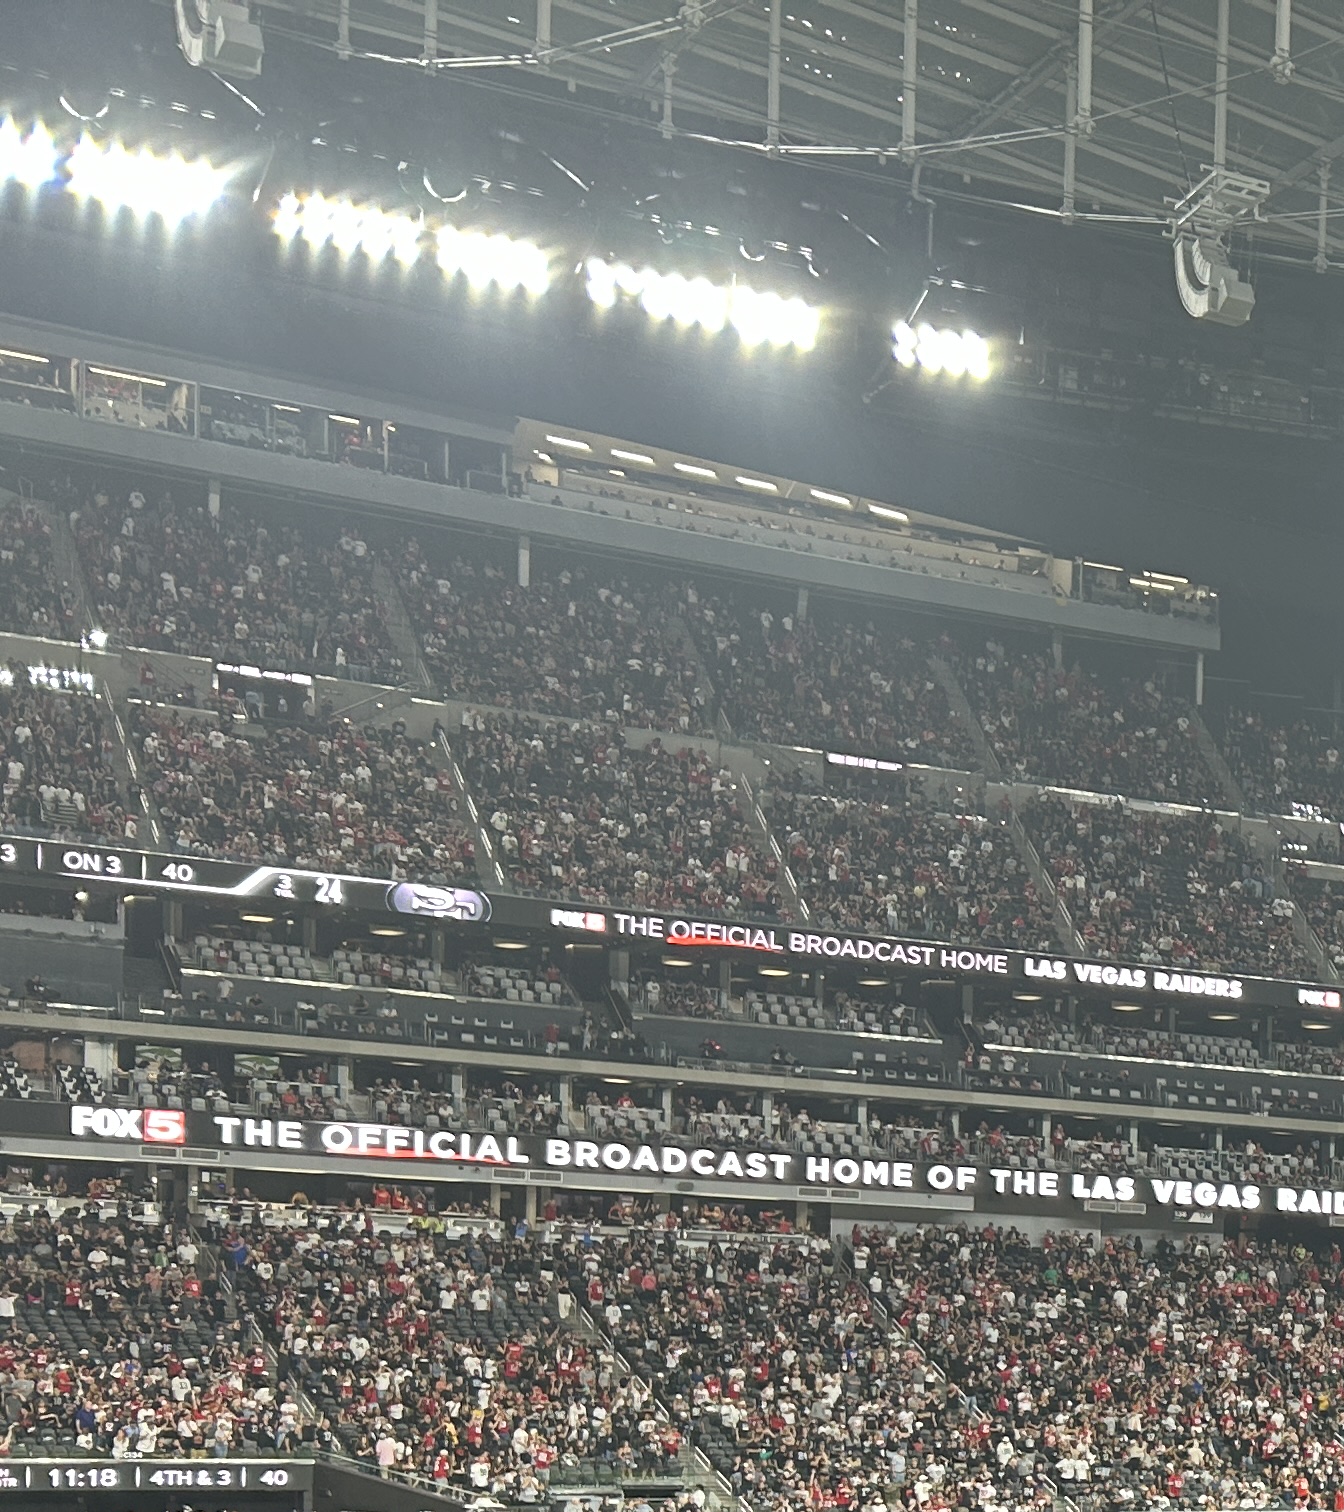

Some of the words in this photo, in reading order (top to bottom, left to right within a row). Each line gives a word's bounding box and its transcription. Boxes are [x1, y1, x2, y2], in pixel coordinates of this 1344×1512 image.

[62, 851, 100, 873] ON
[106, 855, 122, 875] 3
[162, 863, 193, 882] 40
[315, 877, 343, 903] 24
[614, 913, 664, 938] THE
[670, 920, 784, 952] OFFICIAL
[789, 932, 935, 966] BROADCAST
[940, 949, 1008, 974] HOME
[1025, 957, 1067, 981] LAS
[1075, 963, 1147, 988] VEGAS
[1153, 970, 1244, 998] RAIDERS
[212, 1115, 303, 1149] THE
[320, 1123, 529, 1164] OFFICIAL
[546, 1138, 792, 1180] BROADCAST
[806, 1157, 912, 1188] HOME
[928, 1165, 977, 1192] OF
[990, 1169, 1059, 1197] THE
[1071, 1173, 1135, 1201] LAS
[1152, 1178, 1261, 1209] VEGAS
[48, 1467, 118, 1488] 11:18
[149, 1469, 192, 1487] 4TH
[197, 1469, 213, 1486] &
[216, 1470, 232, 1487] 3
[260, 1469, 289, 1486] 40
